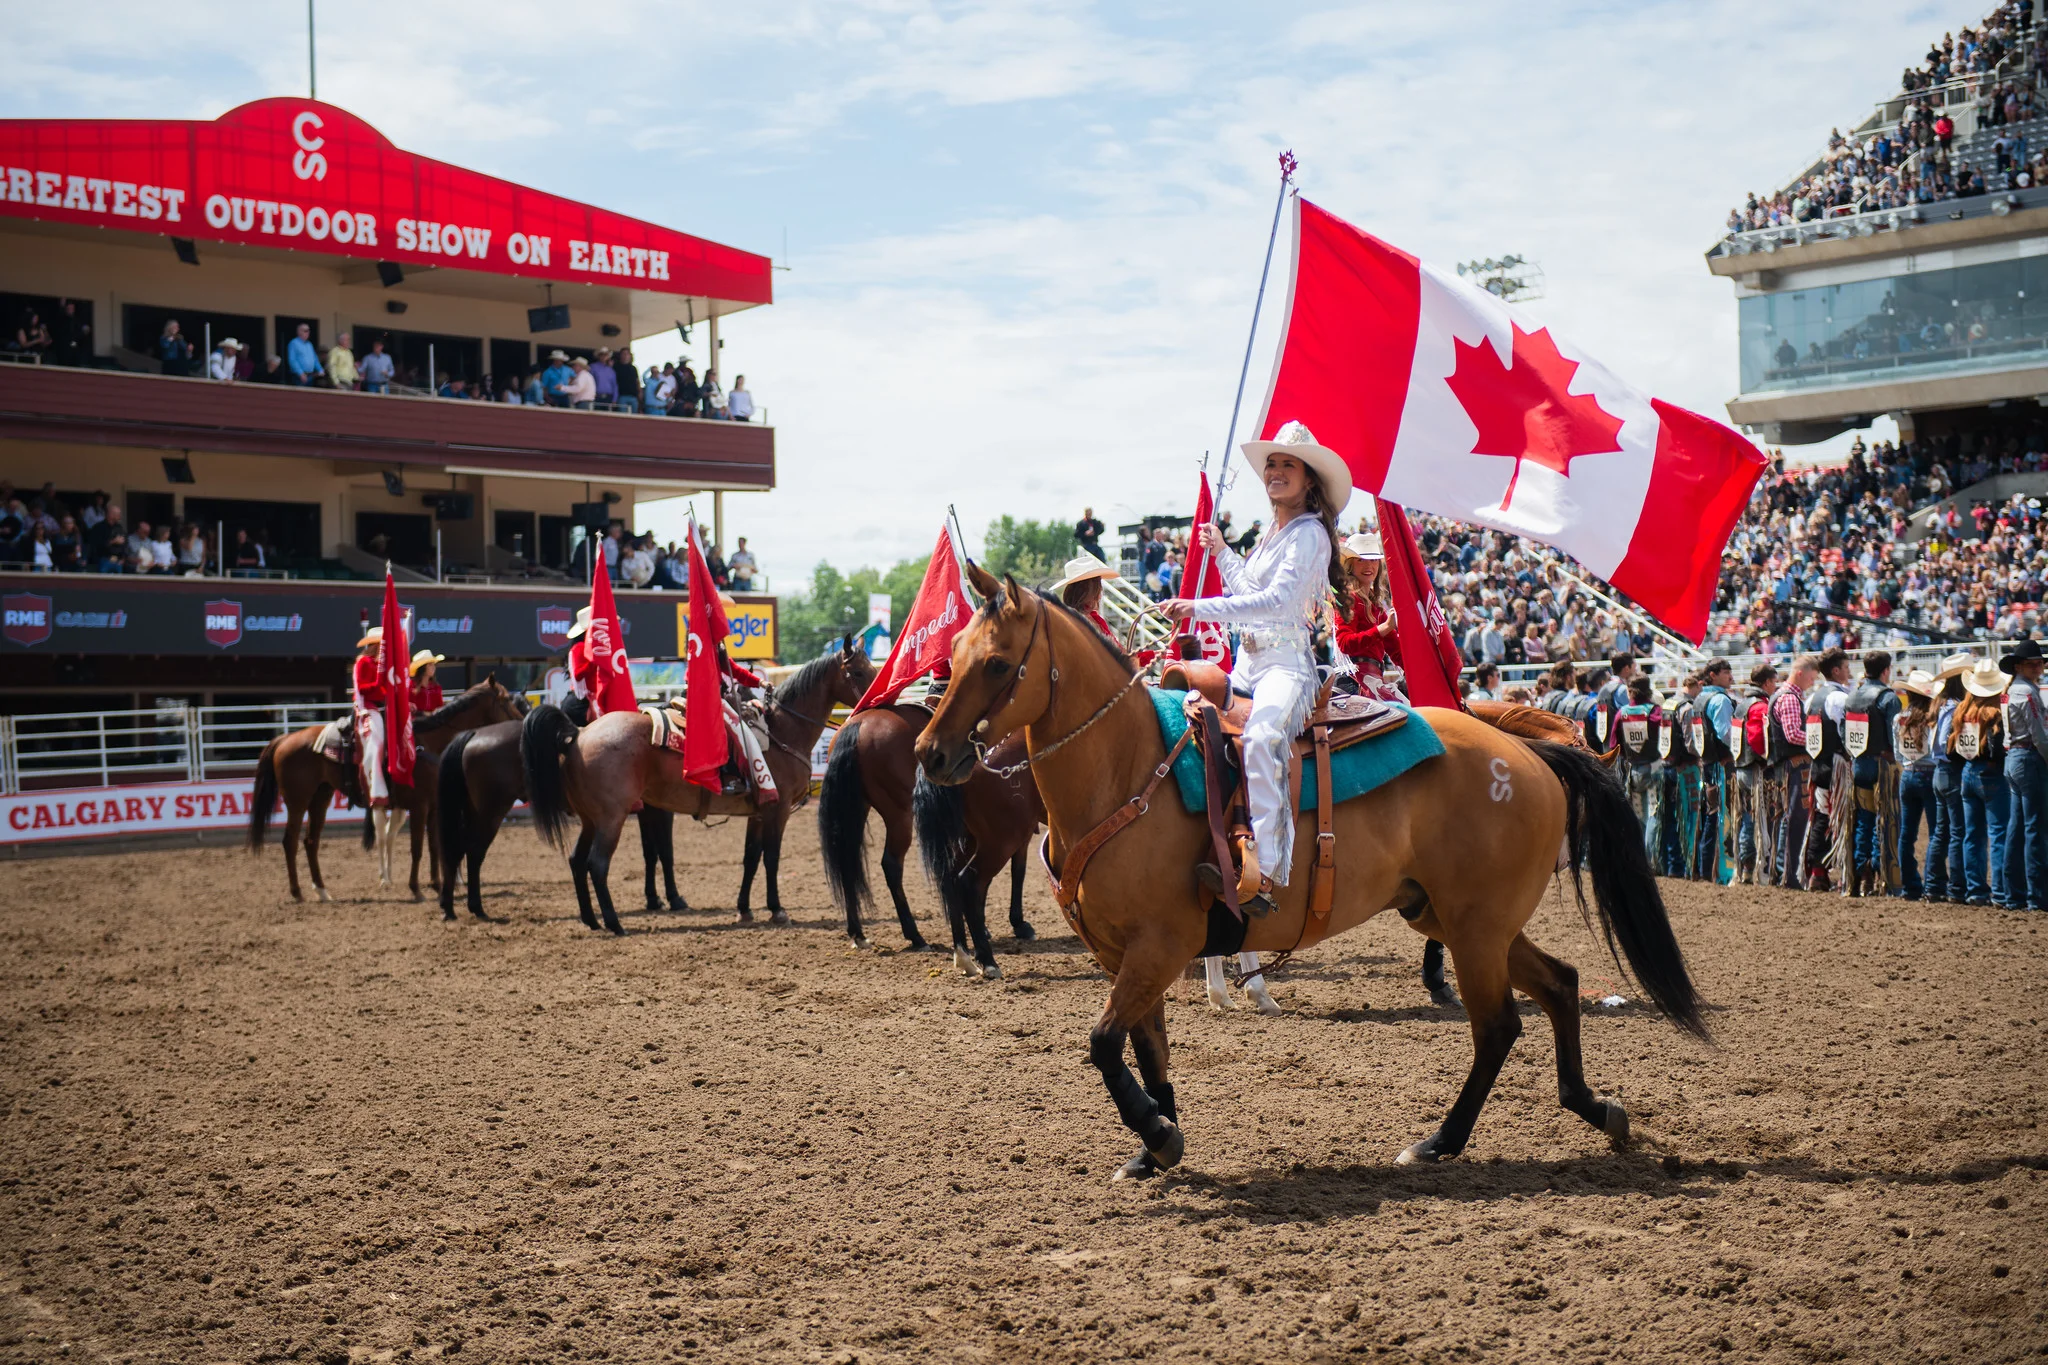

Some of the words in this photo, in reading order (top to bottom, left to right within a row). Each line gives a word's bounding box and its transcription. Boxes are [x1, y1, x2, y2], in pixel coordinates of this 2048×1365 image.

[205, 194, 378, 246] OUTDOOR
[396, 218, 492, 259] SHOW
[507, 232, 551, 267] ON
[569, 240, 670, 281] EARTH
[5, 610, 46, 627] RME
[56, 611, 109, 628] CASE
[206, 615, 237, 630] RME
[244, 616, 287, 631] CASE
[417, 618, 459, 633] CASE
[541, 620, 570, 635] RME
[1629, 731, 1643, 742] 801
[1849, 731, 1864, 744] 802
[1959, 734, 1976, 747] 602
[8, 796, 167, 831] CALGARY
